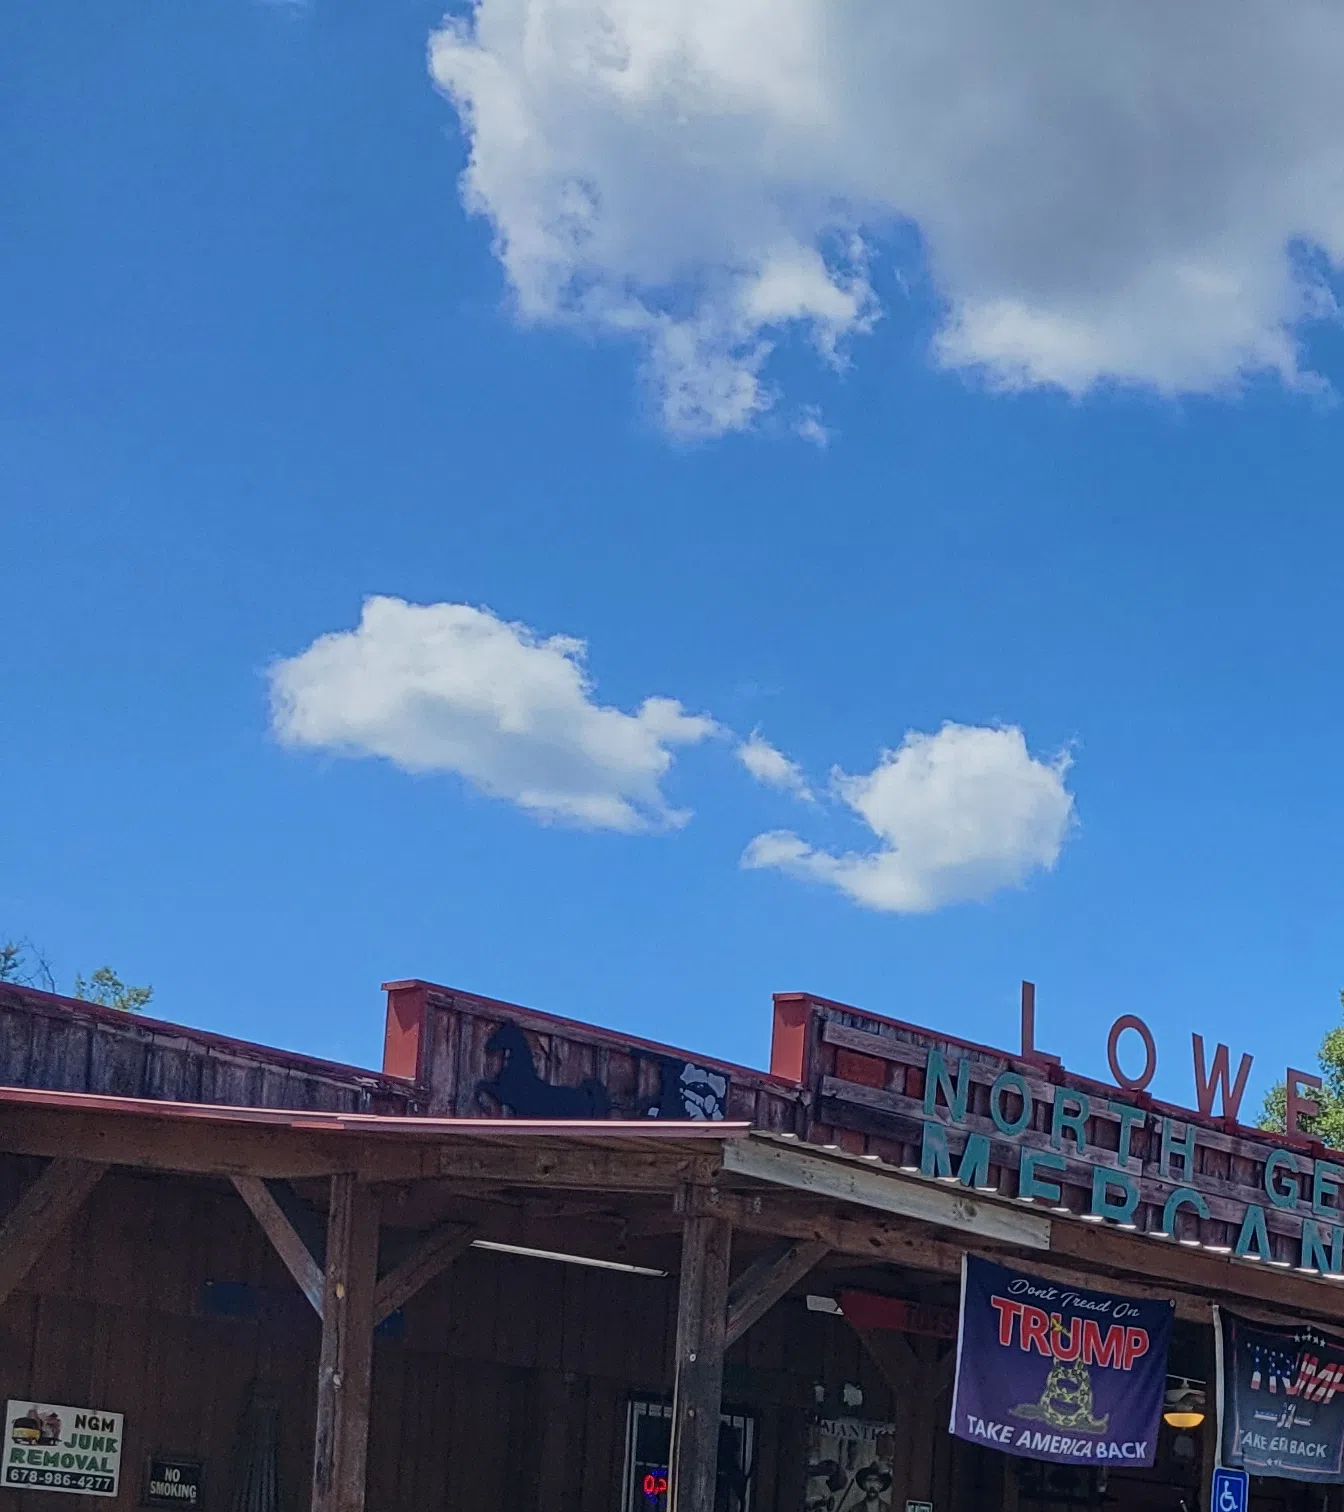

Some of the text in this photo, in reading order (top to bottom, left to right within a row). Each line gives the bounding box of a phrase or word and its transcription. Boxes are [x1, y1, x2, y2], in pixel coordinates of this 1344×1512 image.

[923, 1049, 1196, 1184] NORTH
[1007, 1279, 1141, 1319] Don't Tread On
[990, 1294, 1150, 1371] TRUMP
[74, 1413, 116, 1433] NGM
[63, 1433, 119, 1453] JUNK
[966, 1414, 1148, 1460] TAKE AMERICA BACK
[1289, 1440, 1329, 1458] BACK
[9, 1447, 115, 1474] REMOVAL
[10, 1470, 112, 1491] 678-986-4277
[164, 1467, 181, 1482] NO
[149, 1480, 197, 1499] SMOKING
